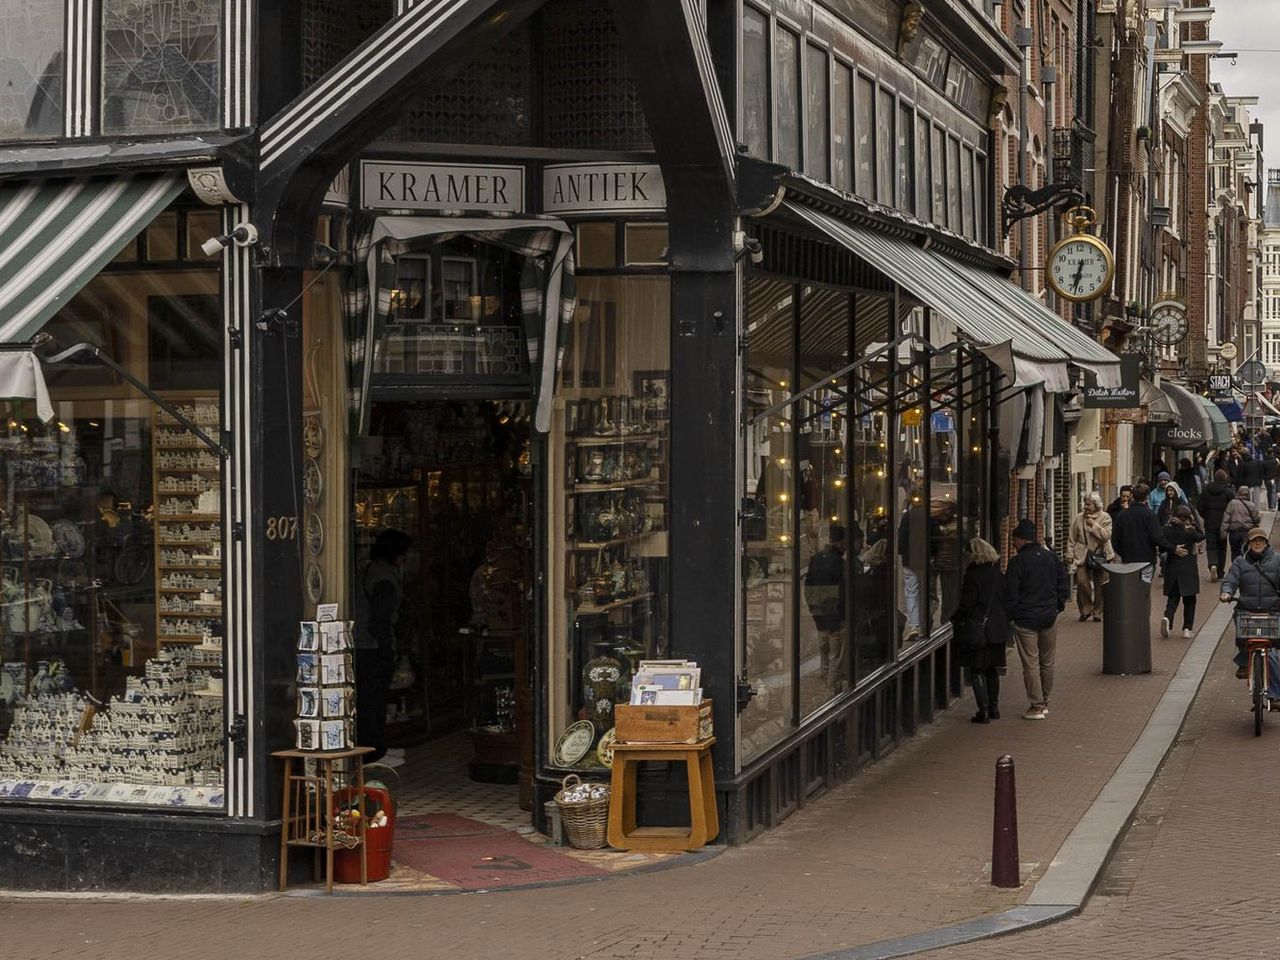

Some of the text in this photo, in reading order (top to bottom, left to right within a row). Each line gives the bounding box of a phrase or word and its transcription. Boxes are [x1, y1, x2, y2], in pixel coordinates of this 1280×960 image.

[378, 171, 508, 204] KRAMER
[552, 172, 649, 204] ANTIEK
[1076, 244, 1084, 252] 12
[1055, 265, 1060, 273] 9
[1058, 276, 1064, 284] 8
[1089, 283, 1095, 291] 5
[1210, 375, 1230, 388] STACH
[1167, 428, 1202, 439] clocks
[266, 516, 297, 540] 807
